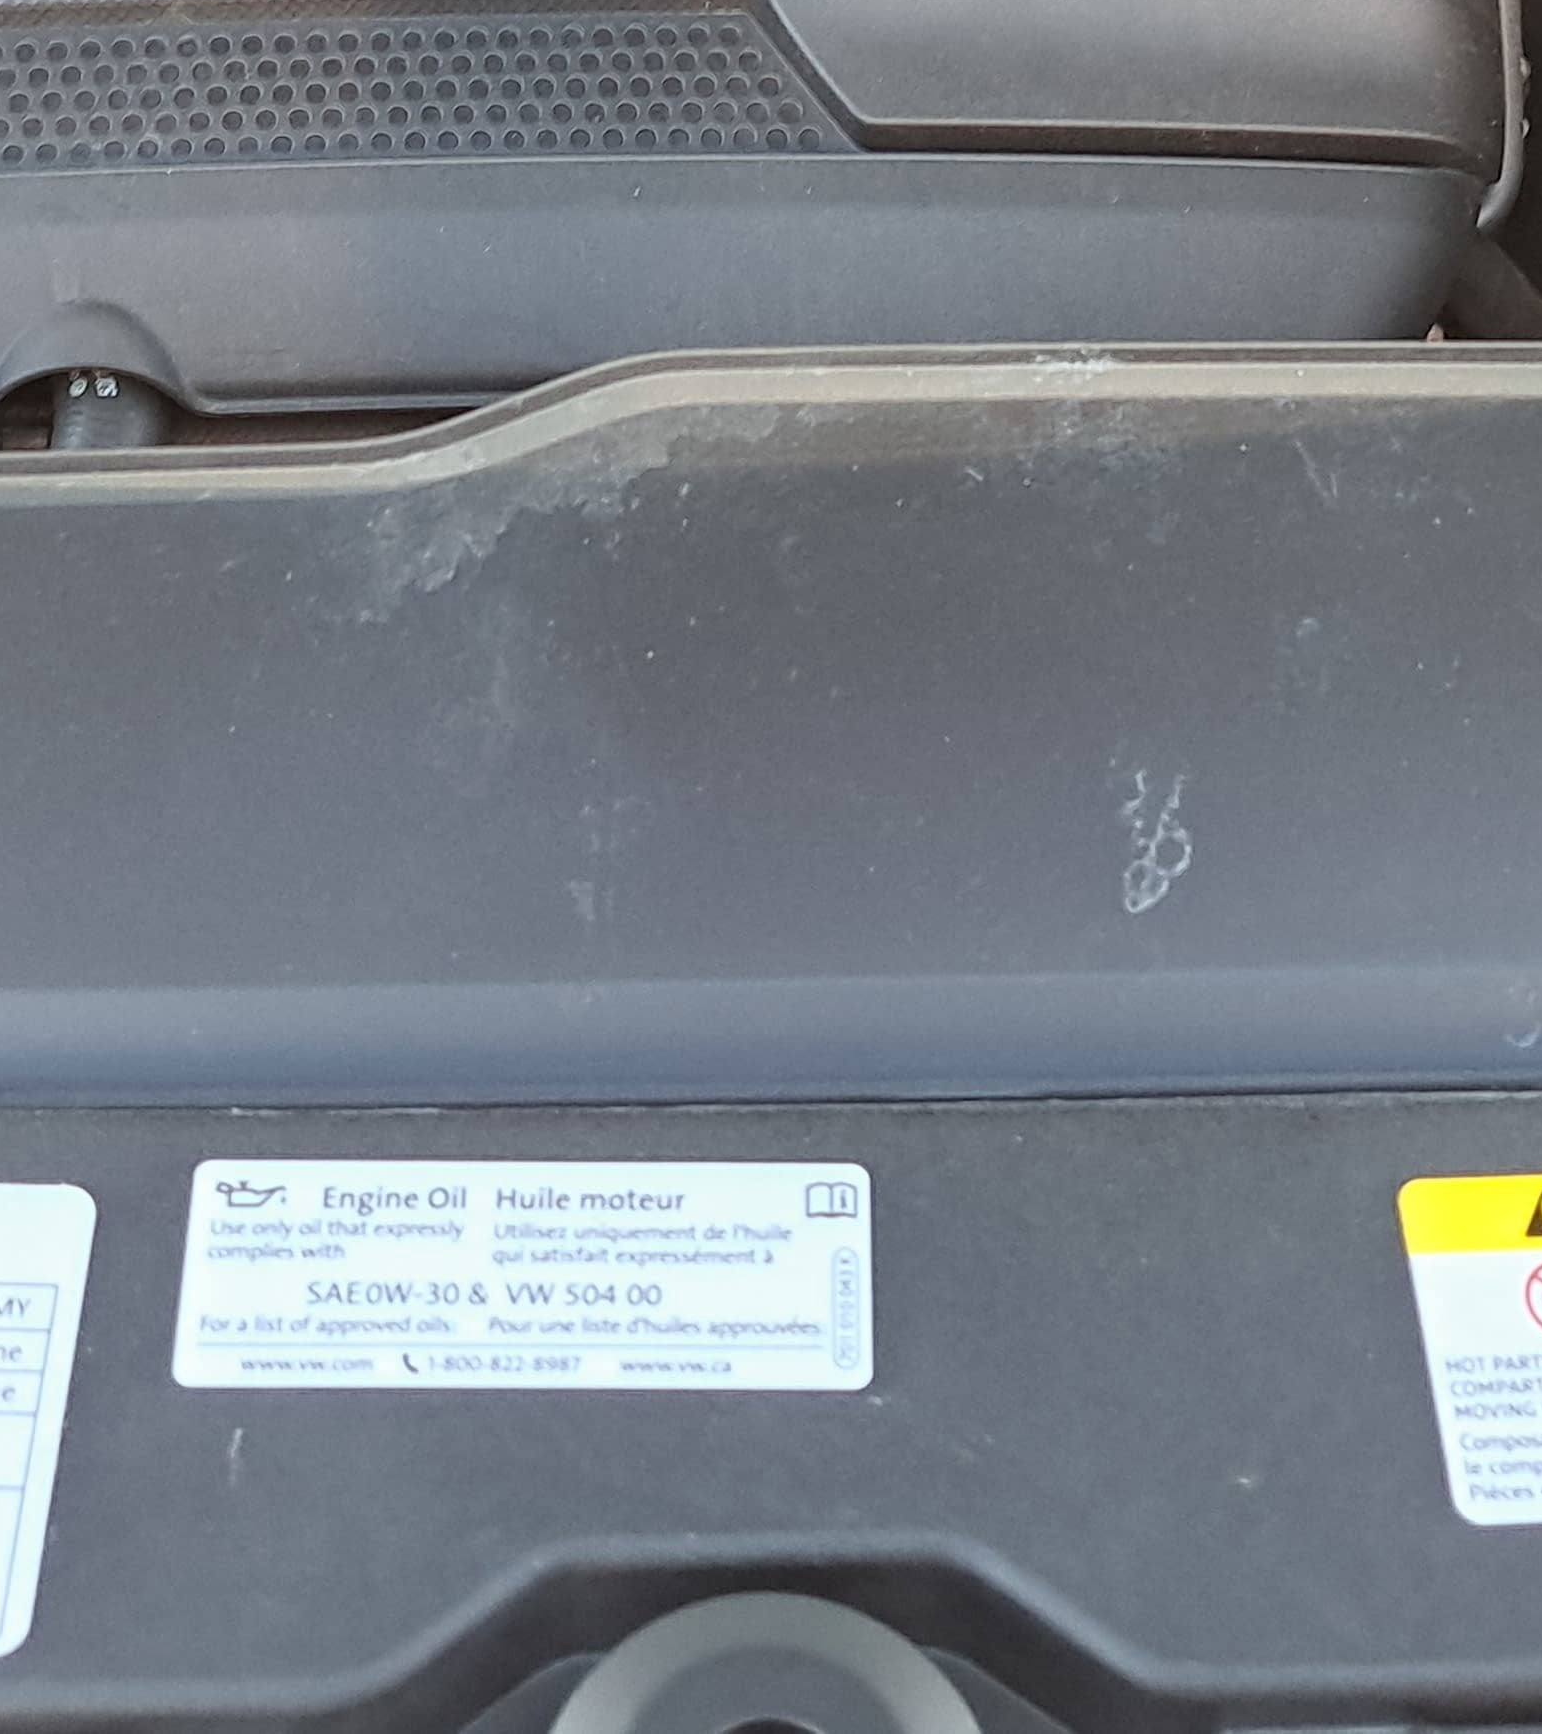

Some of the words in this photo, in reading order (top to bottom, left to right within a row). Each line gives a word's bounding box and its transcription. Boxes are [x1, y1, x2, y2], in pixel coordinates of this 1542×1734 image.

[322, 1186, 419, 1217] Engine
[427, 1187, 467, 1210] Oil
[496, 1186, 571, 1212] Huile
[580, 1188, 685, 1212] moteur
[210, 1220, 246, 1236] Use
[251, 1219, 293, 1241] only
[298, 1219, 322, 1236] oil
[327, 1220, 367, 1237] that
[373, 1221, 465, 1241] expressly
[493, 1222, 567, 1241] Utilisez
[573, 1223, 696, 1247] uniquement
[703, 1225, 726, 1241] de
[733, 1225, 793, 1242] l'huile
[207, 1243, 295, 1262] complies
[301, 1244, 347, 1260] with
[491, 1247, 524, 1267] qui
[530, 1248, 609, 1265] satisfait
[614, 1249, 756, 1268] expressément
[763, 1249, 775, 1266] à
[306, 1281, 461, 1306] SAE0W-30
[468, 1283, 489, 1306] &
[506, 1282, 557, 1307] VW
[563, 1283, 617, 1307] 504
[626, 1283, 664, 1307] 00
[200, 1315, 231, 1333] For
[236, 1317, 248, 1332] a
[253, 1315, 283, 1333] list
[290, 1314, 311, 1333] of
[315, 1316, 411, 1337] approved
[489, 1318, 532, 1334] Pour
[539, 1319, 576, 1334] une
[581, 1318, 621, 1335] liste
[1445, 1355, 1487, 1373] HOT
[1456, 1402, 1538, 1420] MOVING
[1462, 1456, 1484, 1475] le
[1469, 1481, 1534, 1502] Pièces
